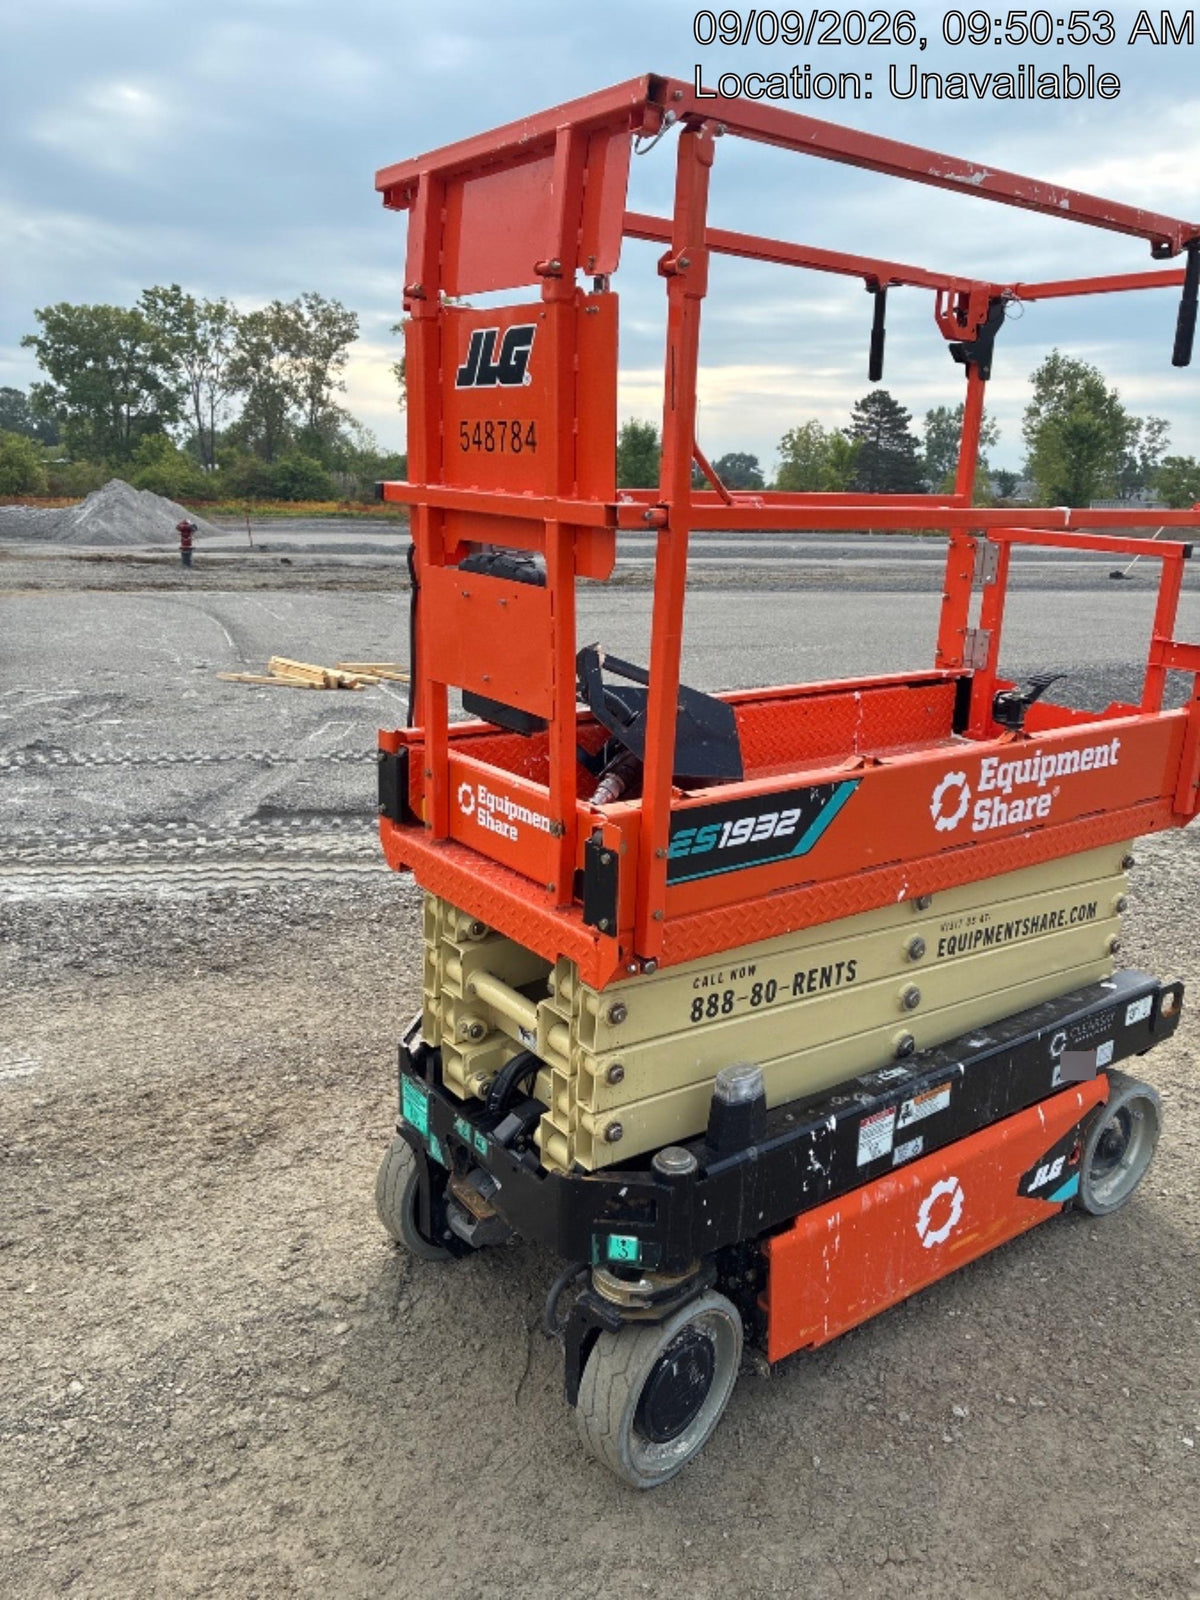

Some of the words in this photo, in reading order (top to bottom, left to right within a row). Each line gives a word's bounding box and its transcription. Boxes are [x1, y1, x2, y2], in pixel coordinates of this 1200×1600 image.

[455, 323, 537, 389] JLG
[460, 420, 537, 453] 548784
[977, 737, 1121, 795] Equipment
[477, 784, 551, 833] Equipmen
[477, 807, 518, 842] Share
[972, 794, 1052, 832] Share
[668, 808, 802, 859] ES1932
[937, 901, 1098, 957] EQUIPMENTSHARE.COM
[690, 959, 858, 1022] 888-80-RENTS
[692, 972, 724, 989] CALL
[730, 964, 757, 980] NOW
[1027, 1154, 1066, 1193] JLG
